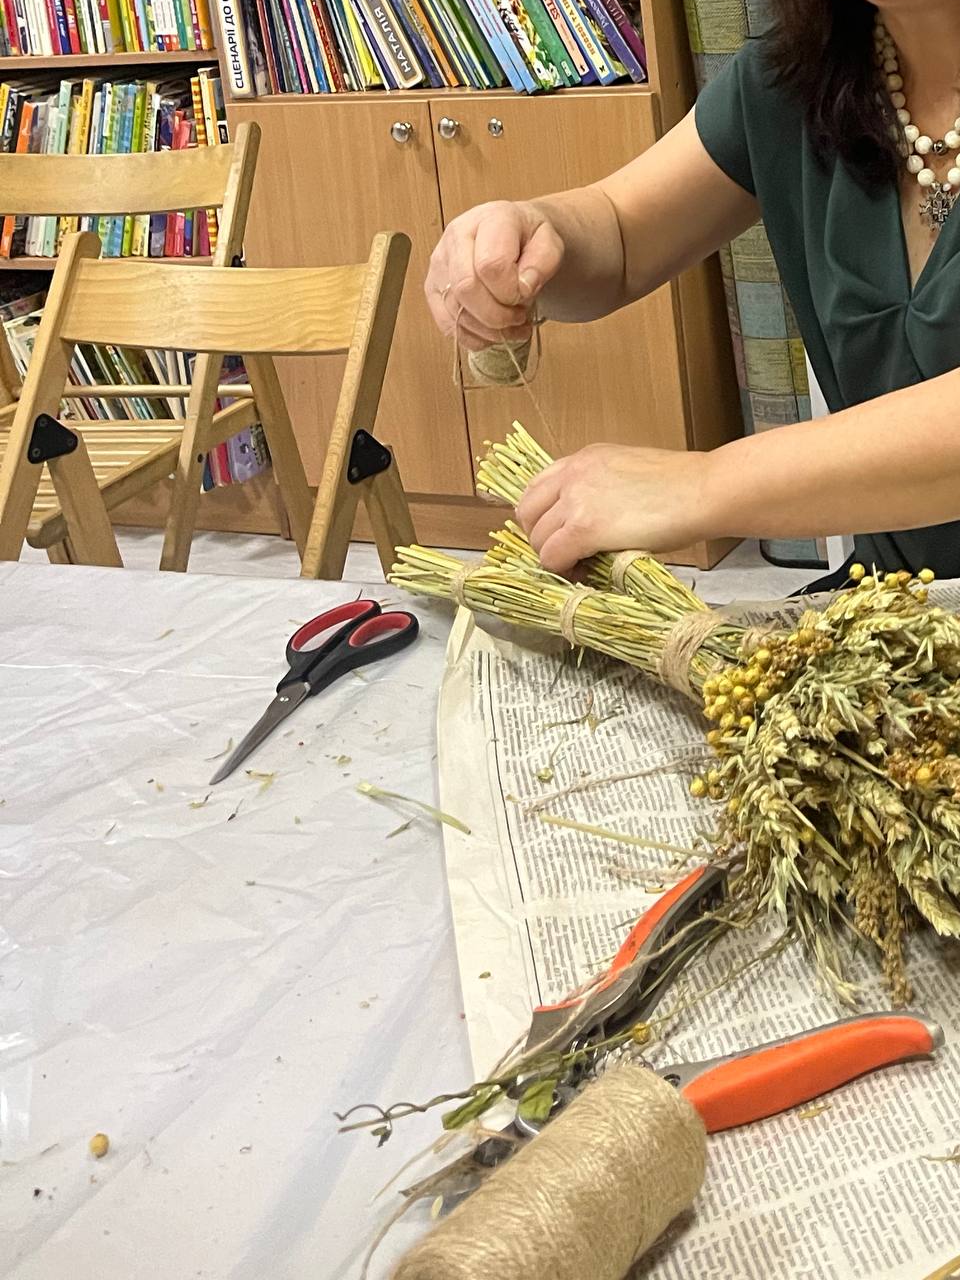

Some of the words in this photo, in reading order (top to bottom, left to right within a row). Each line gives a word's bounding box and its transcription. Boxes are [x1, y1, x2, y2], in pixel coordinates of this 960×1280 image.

[223, 5, 236, 26] ДО
[374, 6, 412, 73] НАТАЛІЯ
[224, 28, 244, 89] СЦЕНАРІЇ
